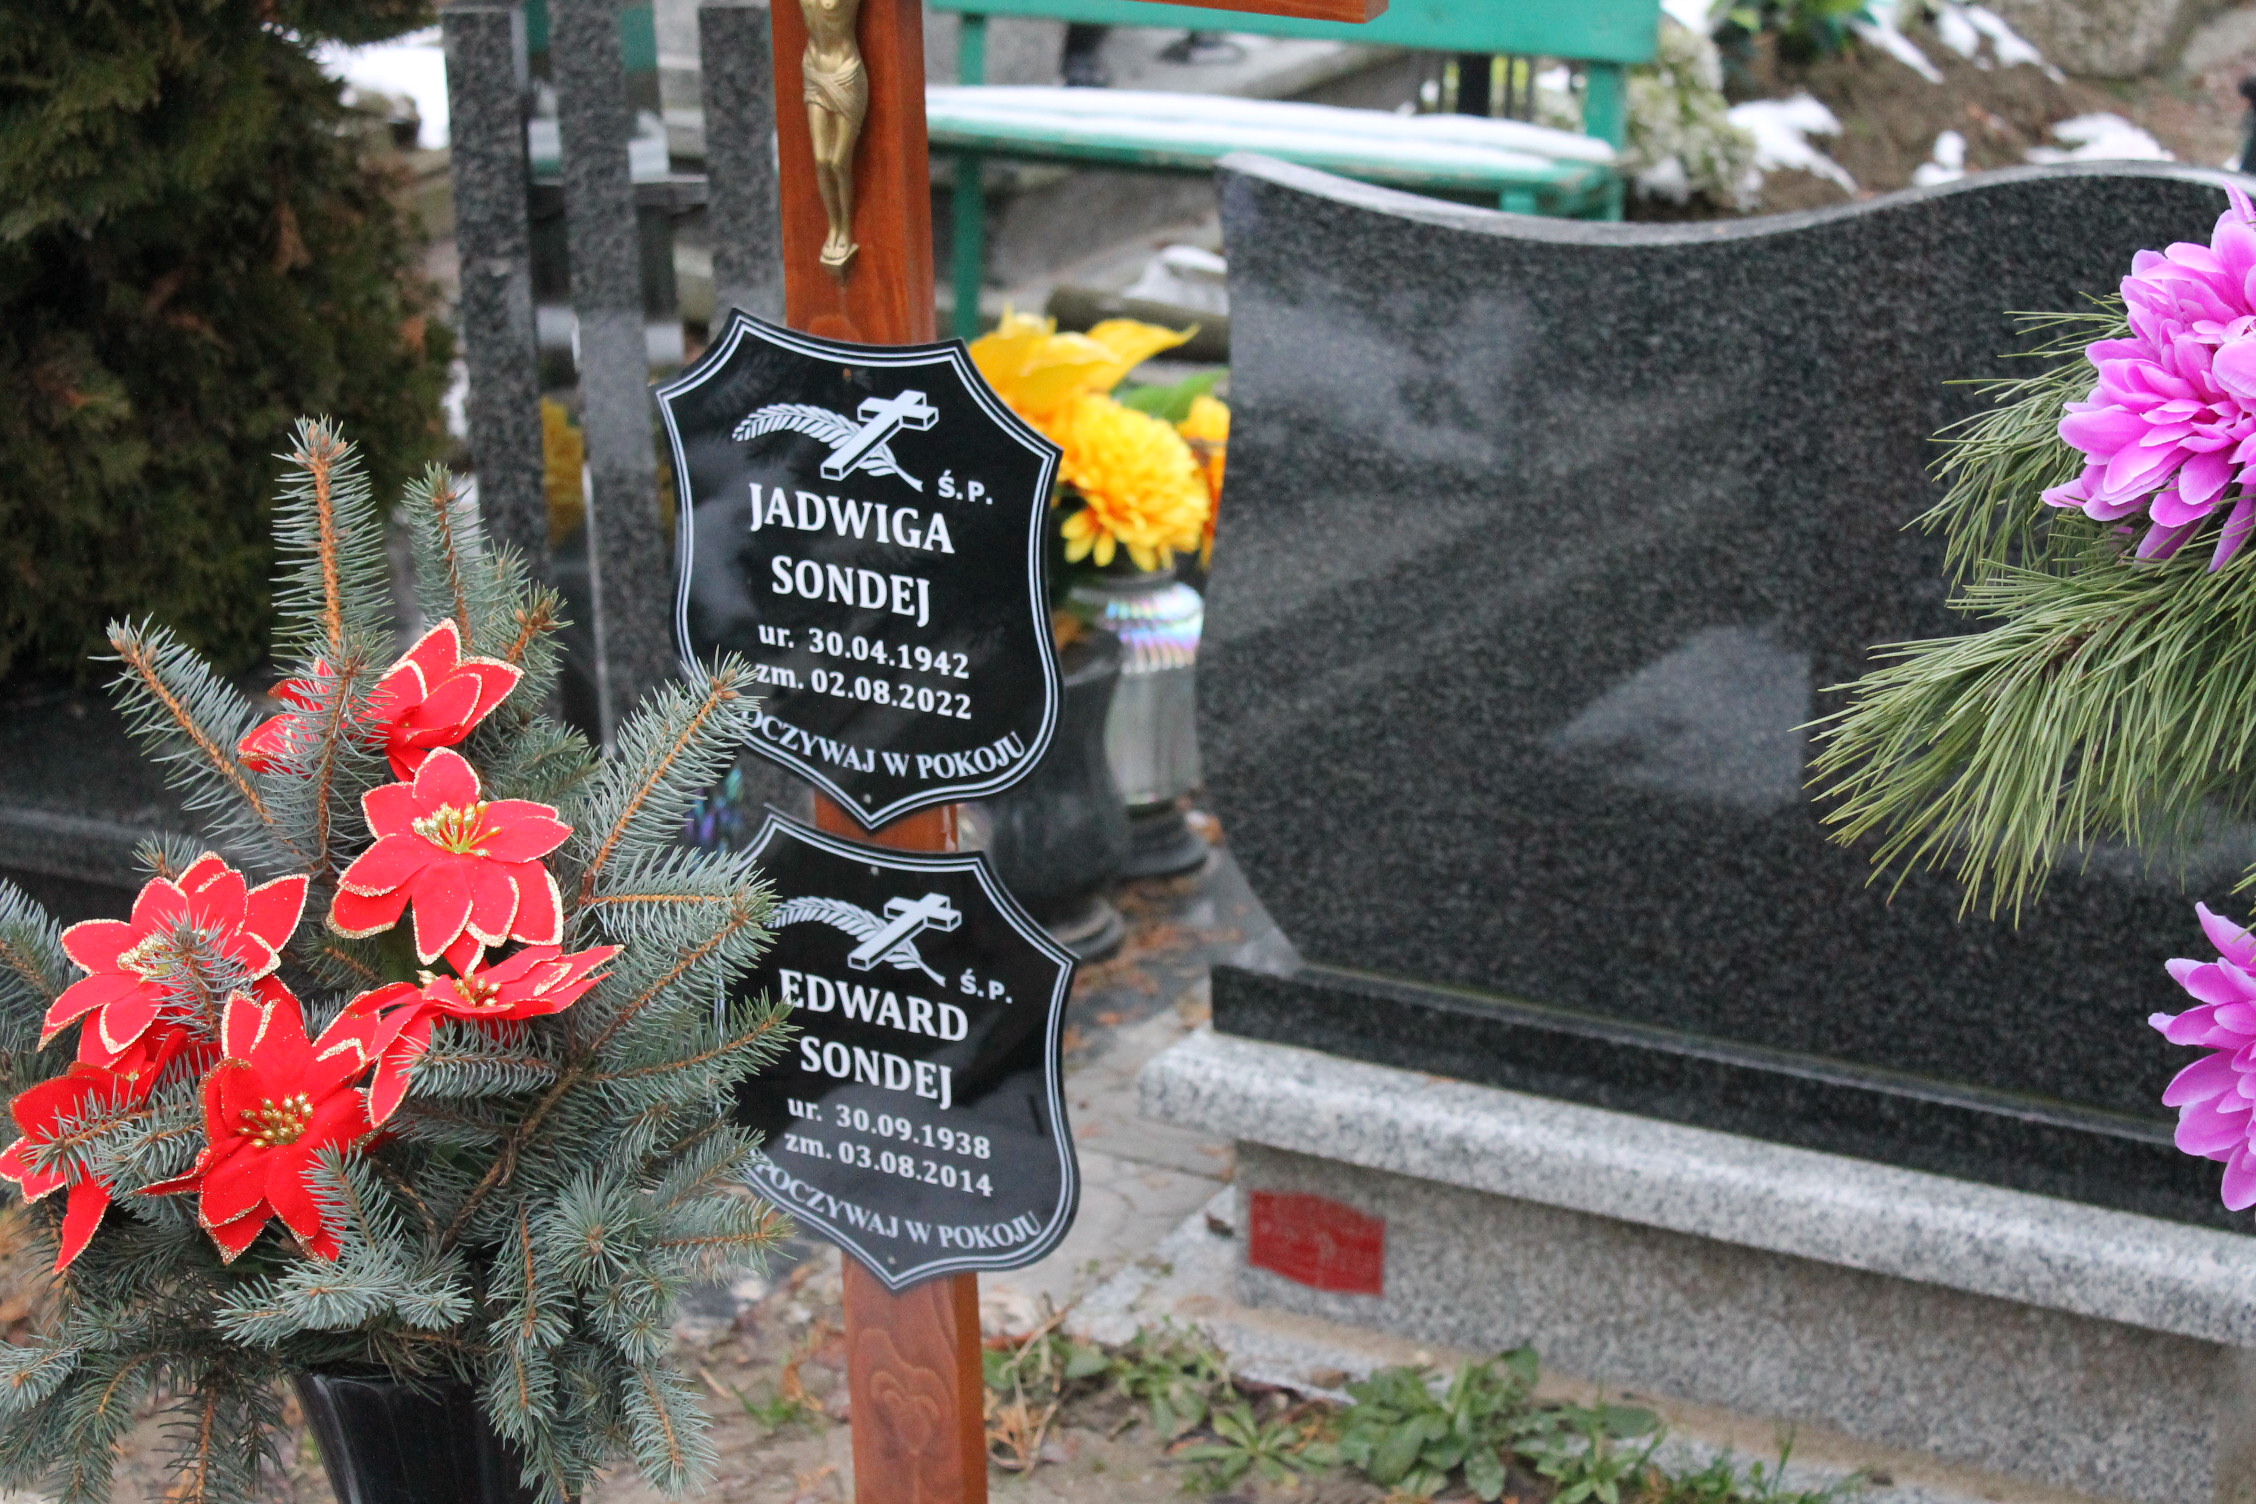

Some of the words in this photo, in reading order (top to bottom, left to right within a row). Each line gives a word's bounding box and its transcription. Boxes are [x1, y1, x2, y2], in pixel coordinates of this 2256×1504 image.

[748, 481, 955, 554] JADWIGA
[771, 555, 930, 628] SONDEJ
[758, 624, 795, 649] ur.
[808, 627, 971, 680] 30.04.1942
[755, 664, 804, 690] zm.
[810, 668, 972, 720] 02.08.2022
[727, 704, 875, 773] OCZYWAJ
[882, 752, 912, 777] W
[916, 731, 1026, 779] POKOJU
[778, 968, 969, 1042] EDWARD
[800, 1035, 952, 1111] SONDEJ
[784, 1132, 832, 1160] zm.
[837, 1141, 994, 1197] 03.08.2014
[787, 1098, 823, 1122] ur.
[835, 1103, 992, 1160] 30.09.1938
[750, 1146, 899, 1239] POCZYWAJ
[905, 1220, 933, 1245] W
[938, 1210, 1042, 1250] POKOJU
